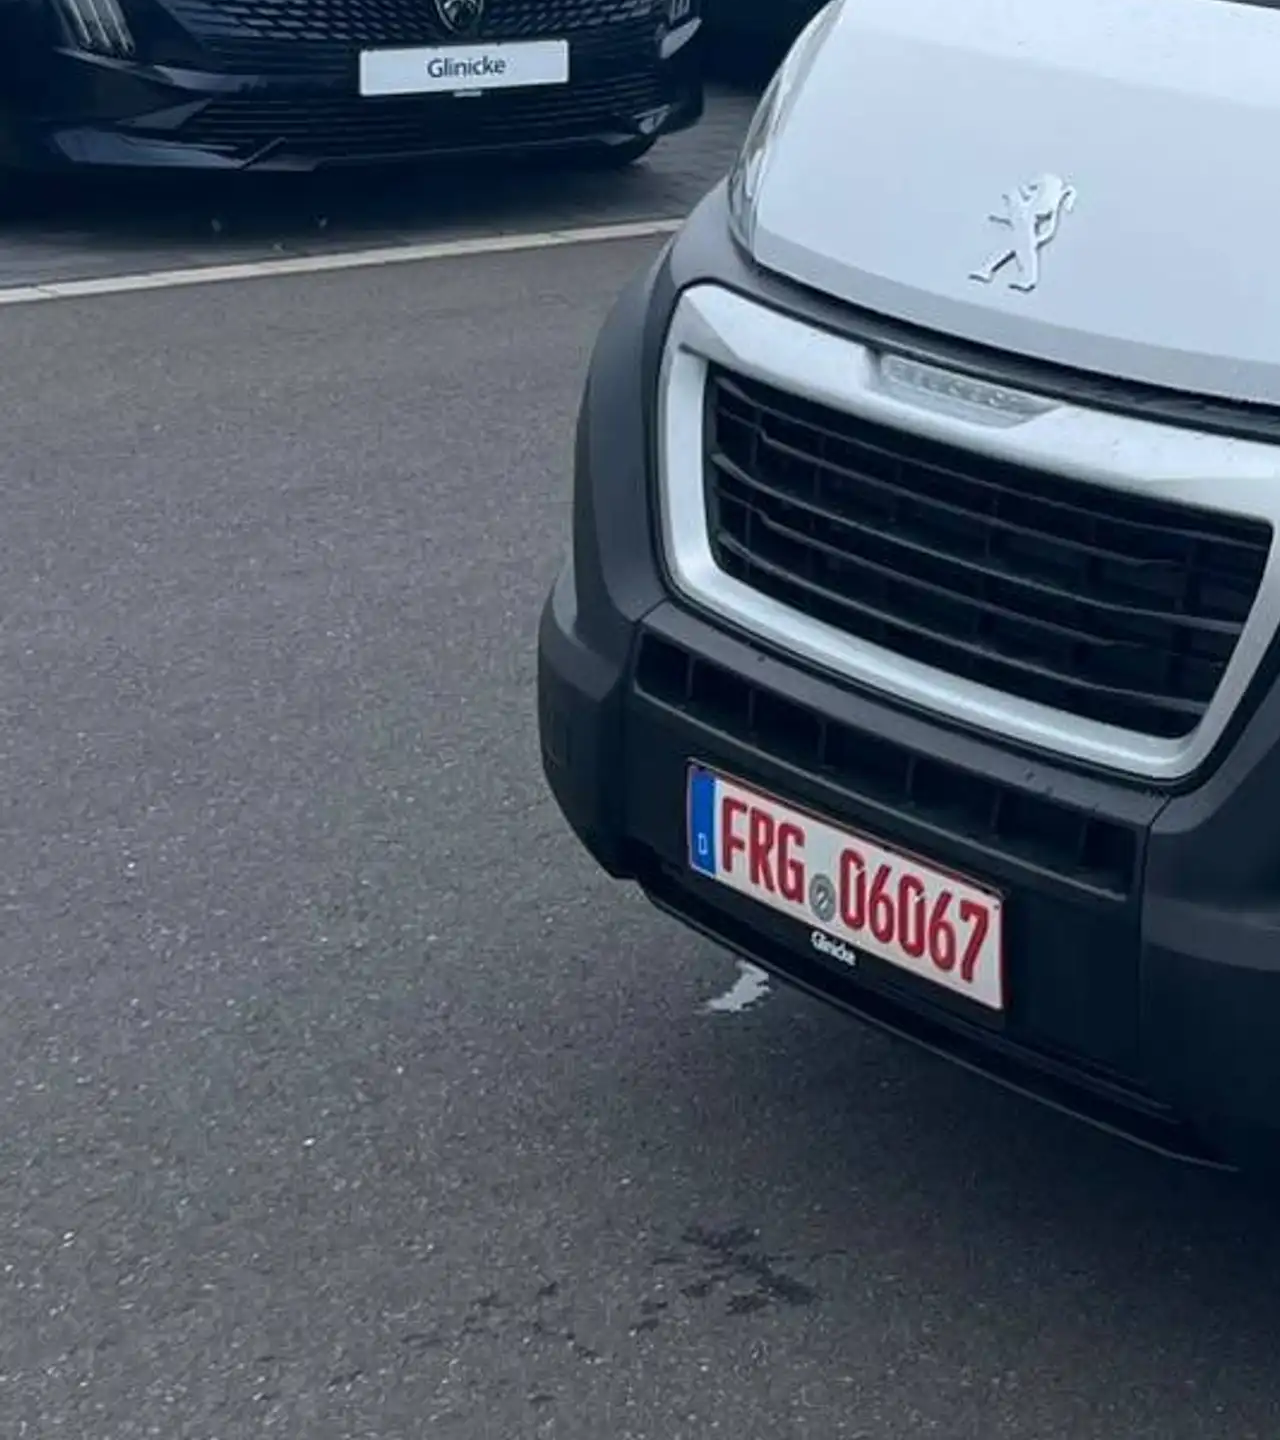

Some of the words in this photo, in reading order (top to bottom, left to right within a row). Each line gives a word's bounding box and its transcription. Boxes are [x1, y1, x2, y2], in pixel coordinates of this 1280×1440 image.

[427, 54, 507, 78] Glinicke
[721, 795, 806, 905] FRG
[839, 847, 990, 983] 06067
